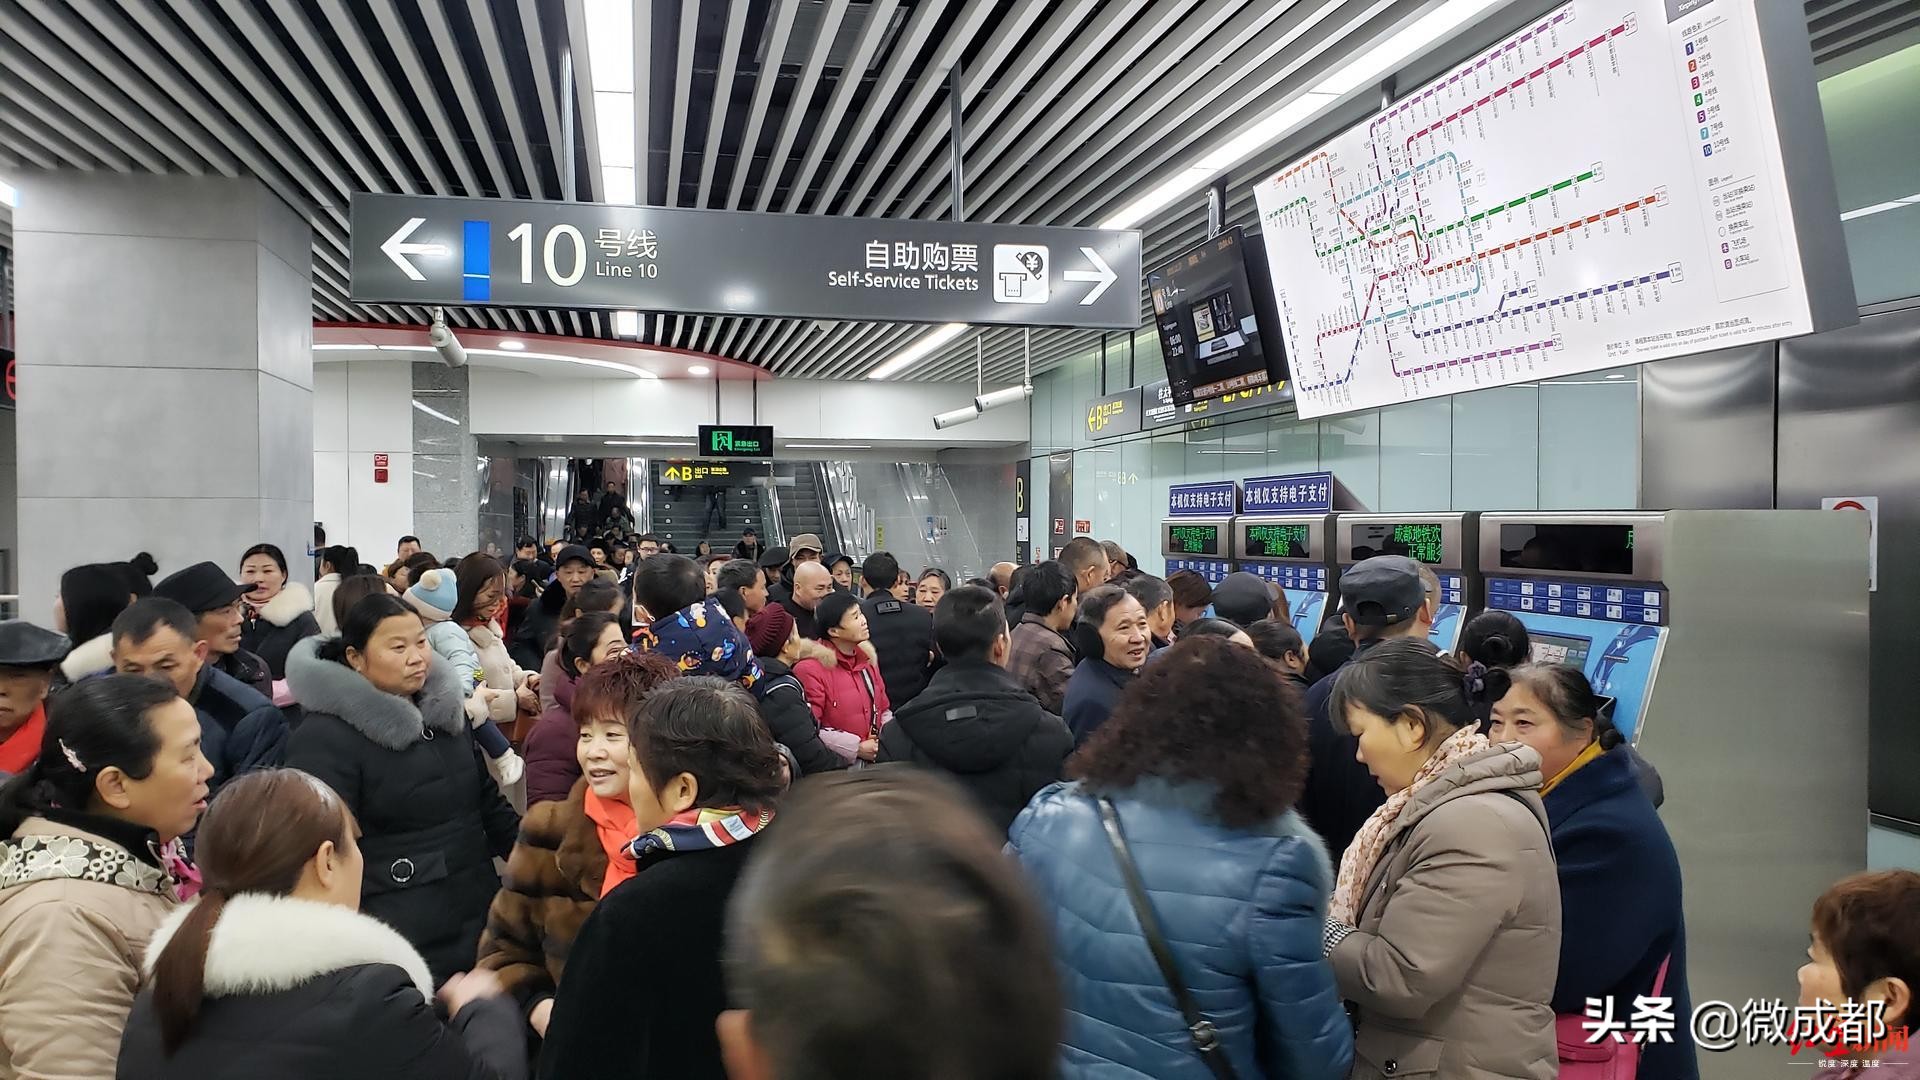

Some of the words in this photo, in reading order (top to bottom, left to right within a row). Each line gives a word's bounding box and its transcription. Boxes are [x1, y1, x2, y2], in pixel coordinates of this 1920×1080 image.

[507, 222, 587, 288] 10
[595, 228, 658, 259] 号线
[865, 240, 979, 272] 自助购票
[596, 261, 632, 278] Line
[638, 263, 658, 279] 10
[828, 271, 920, 290] Self-Service
[925, 274, 979, 292] Tickets
[1097, 406, 1103, 431] B
[682, 467, 693, 481] B
[695, 467, 709, 475] 出口
[1017, 477, 1024, 513] B
[1171, 490, 1232, 509] 本机仅支持电子支付
[1246, 482, 1328, 505] 本机仅支持电子支付
[1172, 528, 1216, 540] 本机仅支持电子支付
[1250, 526, 1307, 542] 本机仅支持电子支付
[1184, 540, 1204, 553] 正常服务
[1264, 541, 1290, 557] 正常服务
